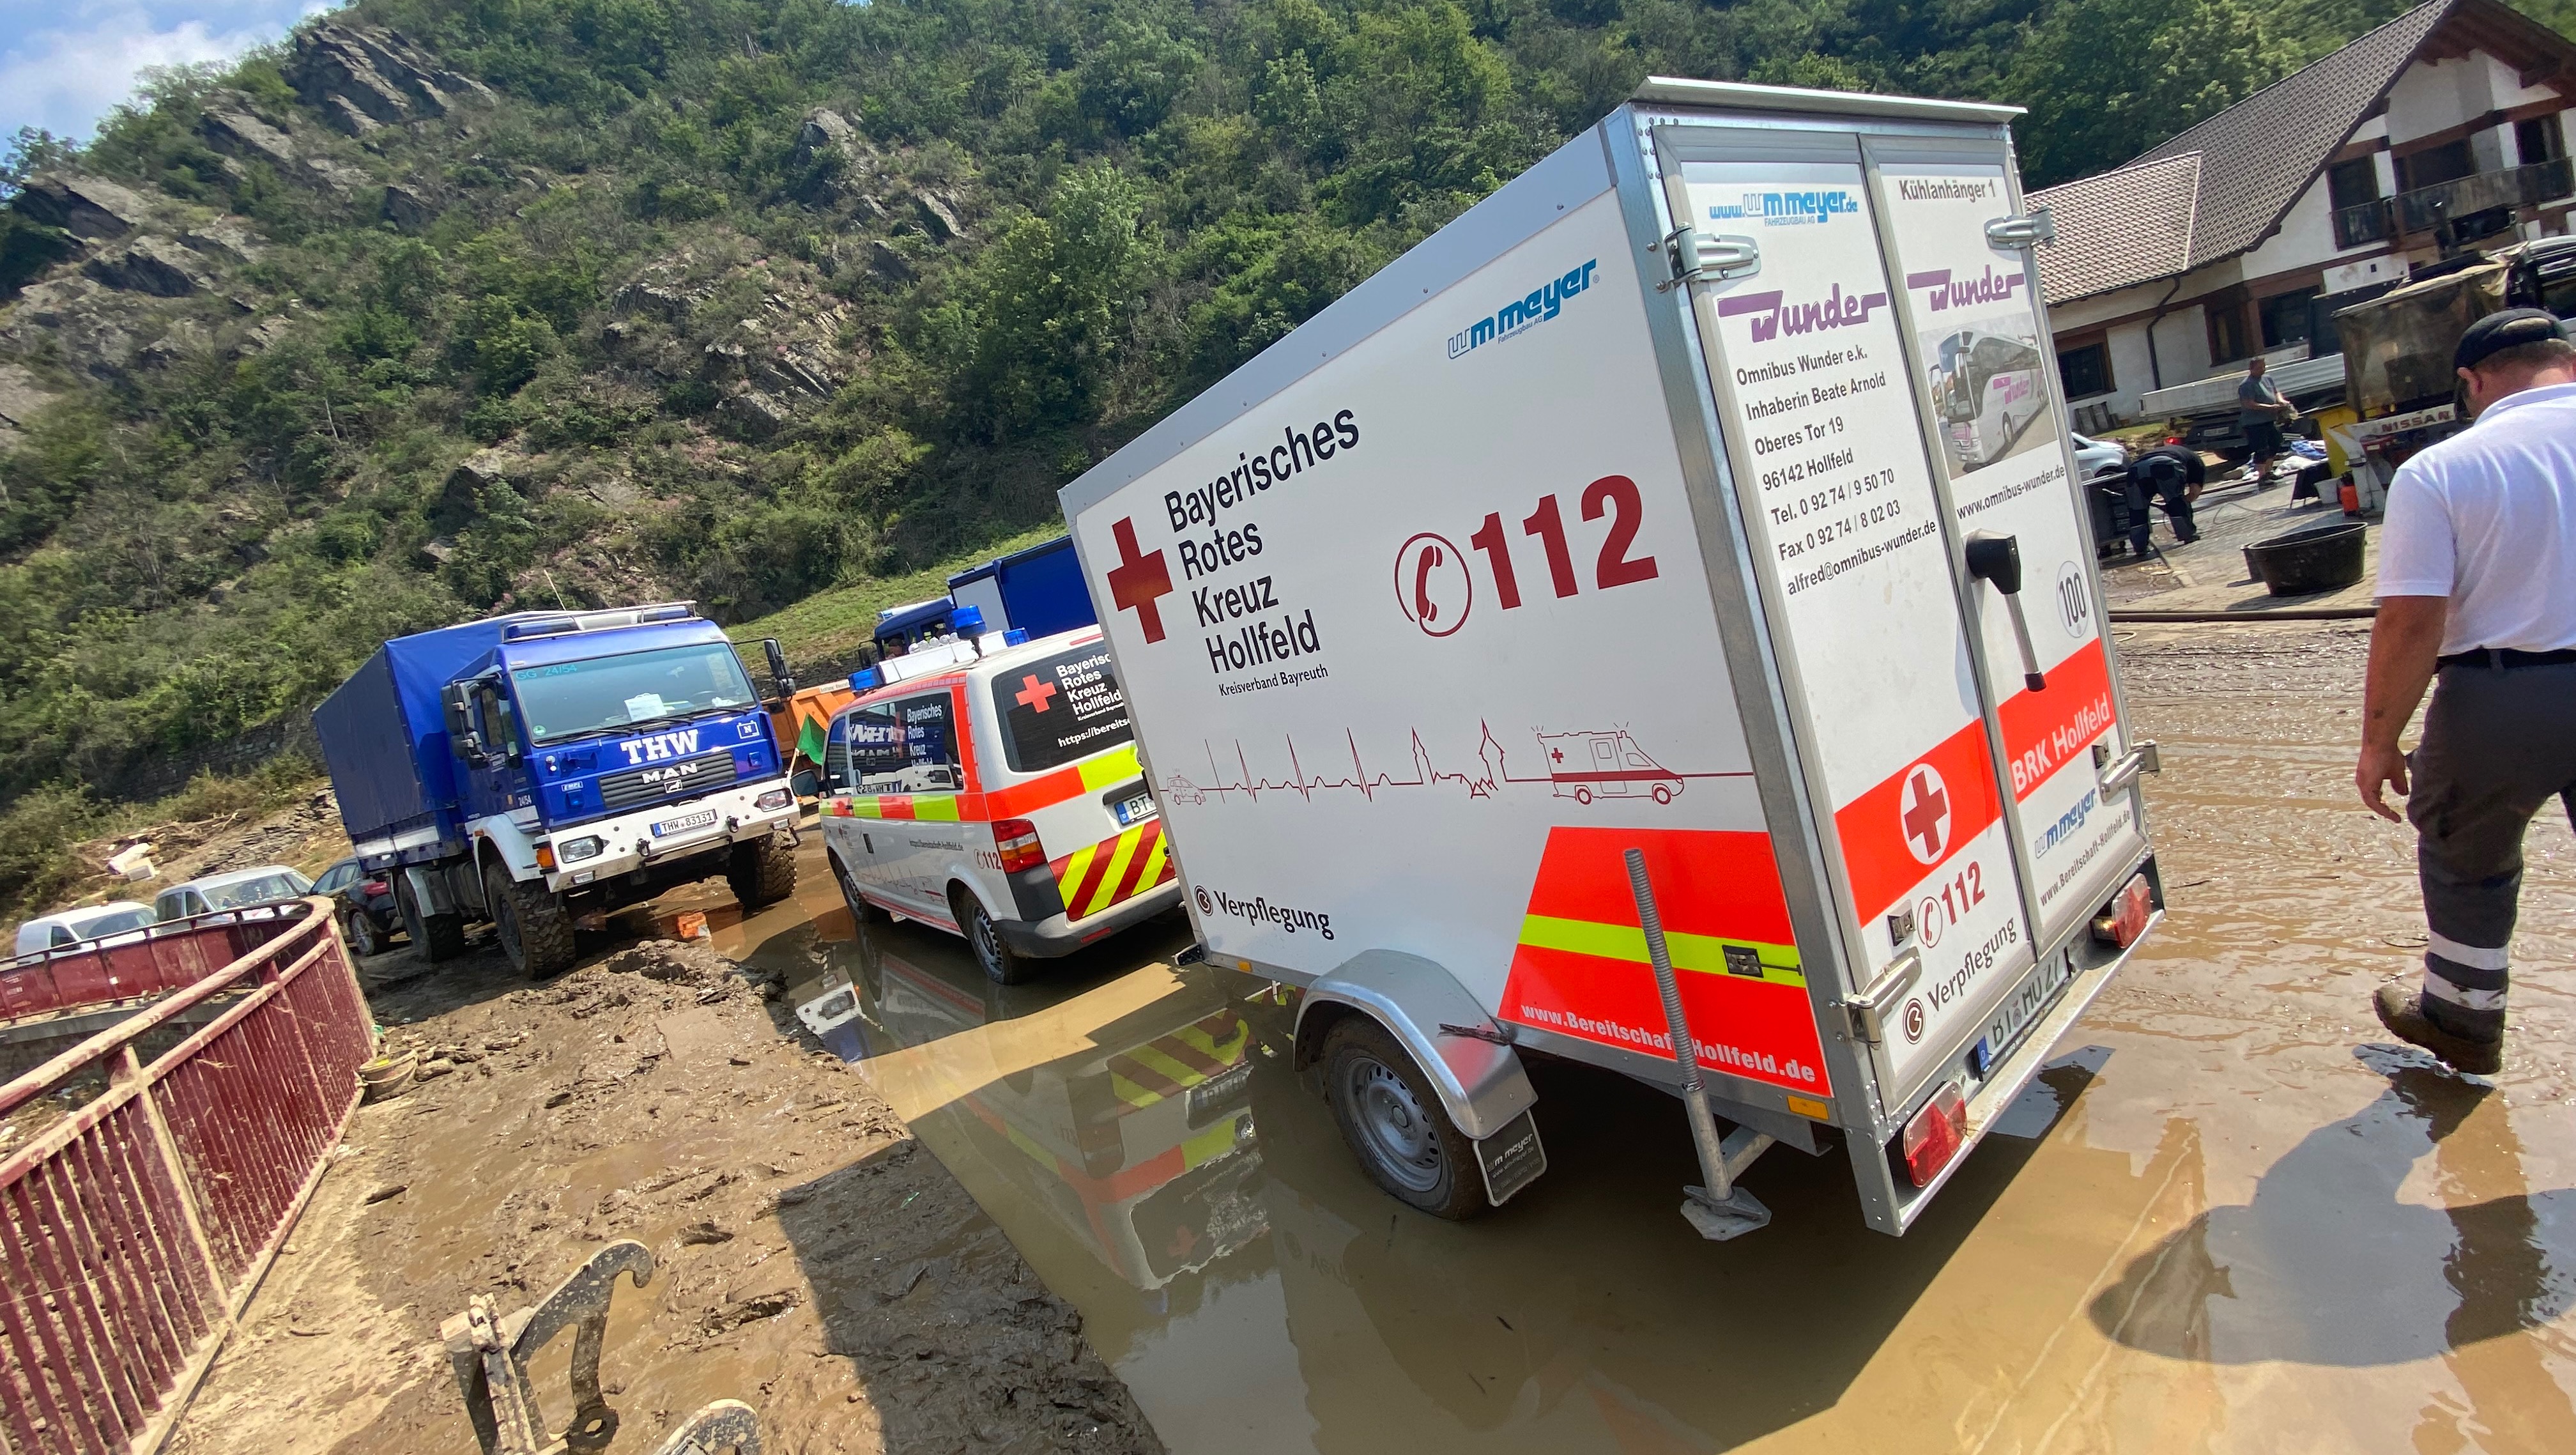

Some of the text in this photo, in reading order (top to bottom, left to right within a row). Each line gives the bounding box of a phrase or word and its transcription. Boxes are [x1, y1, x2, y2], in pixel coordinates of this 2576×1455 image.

[1899, 179, 1995, 203] Kühlanhänger 1
[1764, 215, 1815, 227] FAHRZEUGBAU AG
[1906, 265, 2024, 311] Wunder
[1498, 315, 1543, 344] Fahrzeugbau AG
[1717, 283, 1887, 343] Wunder
[1736, 344, 1867, 385] Omnibus Wunder e.k.
[1745, 371, 1885, 420] Inhaberin Beate Arnold
[1755, 416, 1844, 455] Oberes Tor 19
[2381, 411, 2450, 432] NISSAN
[1164, 409, 1359, 532] Bayerisches
[1763, 447, 1853, 491] 96142 Hollfeld
[1771, 504, 1797, 525] Tel.
[1800, 498, 1808, 515] 0
[1811, 492, 1828, 511] 92
[1829, 485, 1845, 505] 74
[1854, 480, 1862, 495] 9
[1865, 473, 1878, 491] 50
[1880, 468, 1894, 486] 70
[1956, 465, 2066, 520] www.omnibus-wunder.de
[1471, 474, 1659, 610] 112
[1779, 540, 1805, 560] Fax
[1807, 532, 1815, 550] 0
[1818, 526, 1834, 544] 92
[1836, 518, 1851, 537] 74
[1860, 512, 1868, 528] 8
[1871, 505, 1885, 524] 02
[1887, 500, 1900, 518] 03
[1178, 523, 1262, 580] Rotes
[1788, 520, 1936, 595] alfred@omnibus-wunder.de
[1192, 575, 1279, 627] Kreuz
[2059, 572, 2086, 627] 100
[1206, 609, 1321, 674] Hollfeld
[516, 664, 577, 680] GG 24/54
[1061, 670, 1102, 690] Rotes
[1066, 682, 1107, 702] Kreuz
[1219, 663, 1329, 696] Kreisverband Bayreuth
[907, 703, 942, 724] Bayerisches
[1072, 689, 1123, 715] Hollfeld
[620, 728, 698, 764] THW
[908, 725, 924, 740] Rotes
[908, 743, 926, 757] Kreuz
[2012, 692, 2110, 794] BRK Hollfeld
[642, 762, 698, 784] MAN
[662, 812, 712, 832] THW 83131
[1130, 796, 1147, 815] BT
[983, 851, 1002, 870] 112
[2040, 810, 2131, 907] www.Bereitschaft-Hollfeld.de
[1941, 861, 1985, 926] 112
[1214, 890, 1335, 941] Verpflegung
[1928, 917, 2016, 1012] Verpflegung
